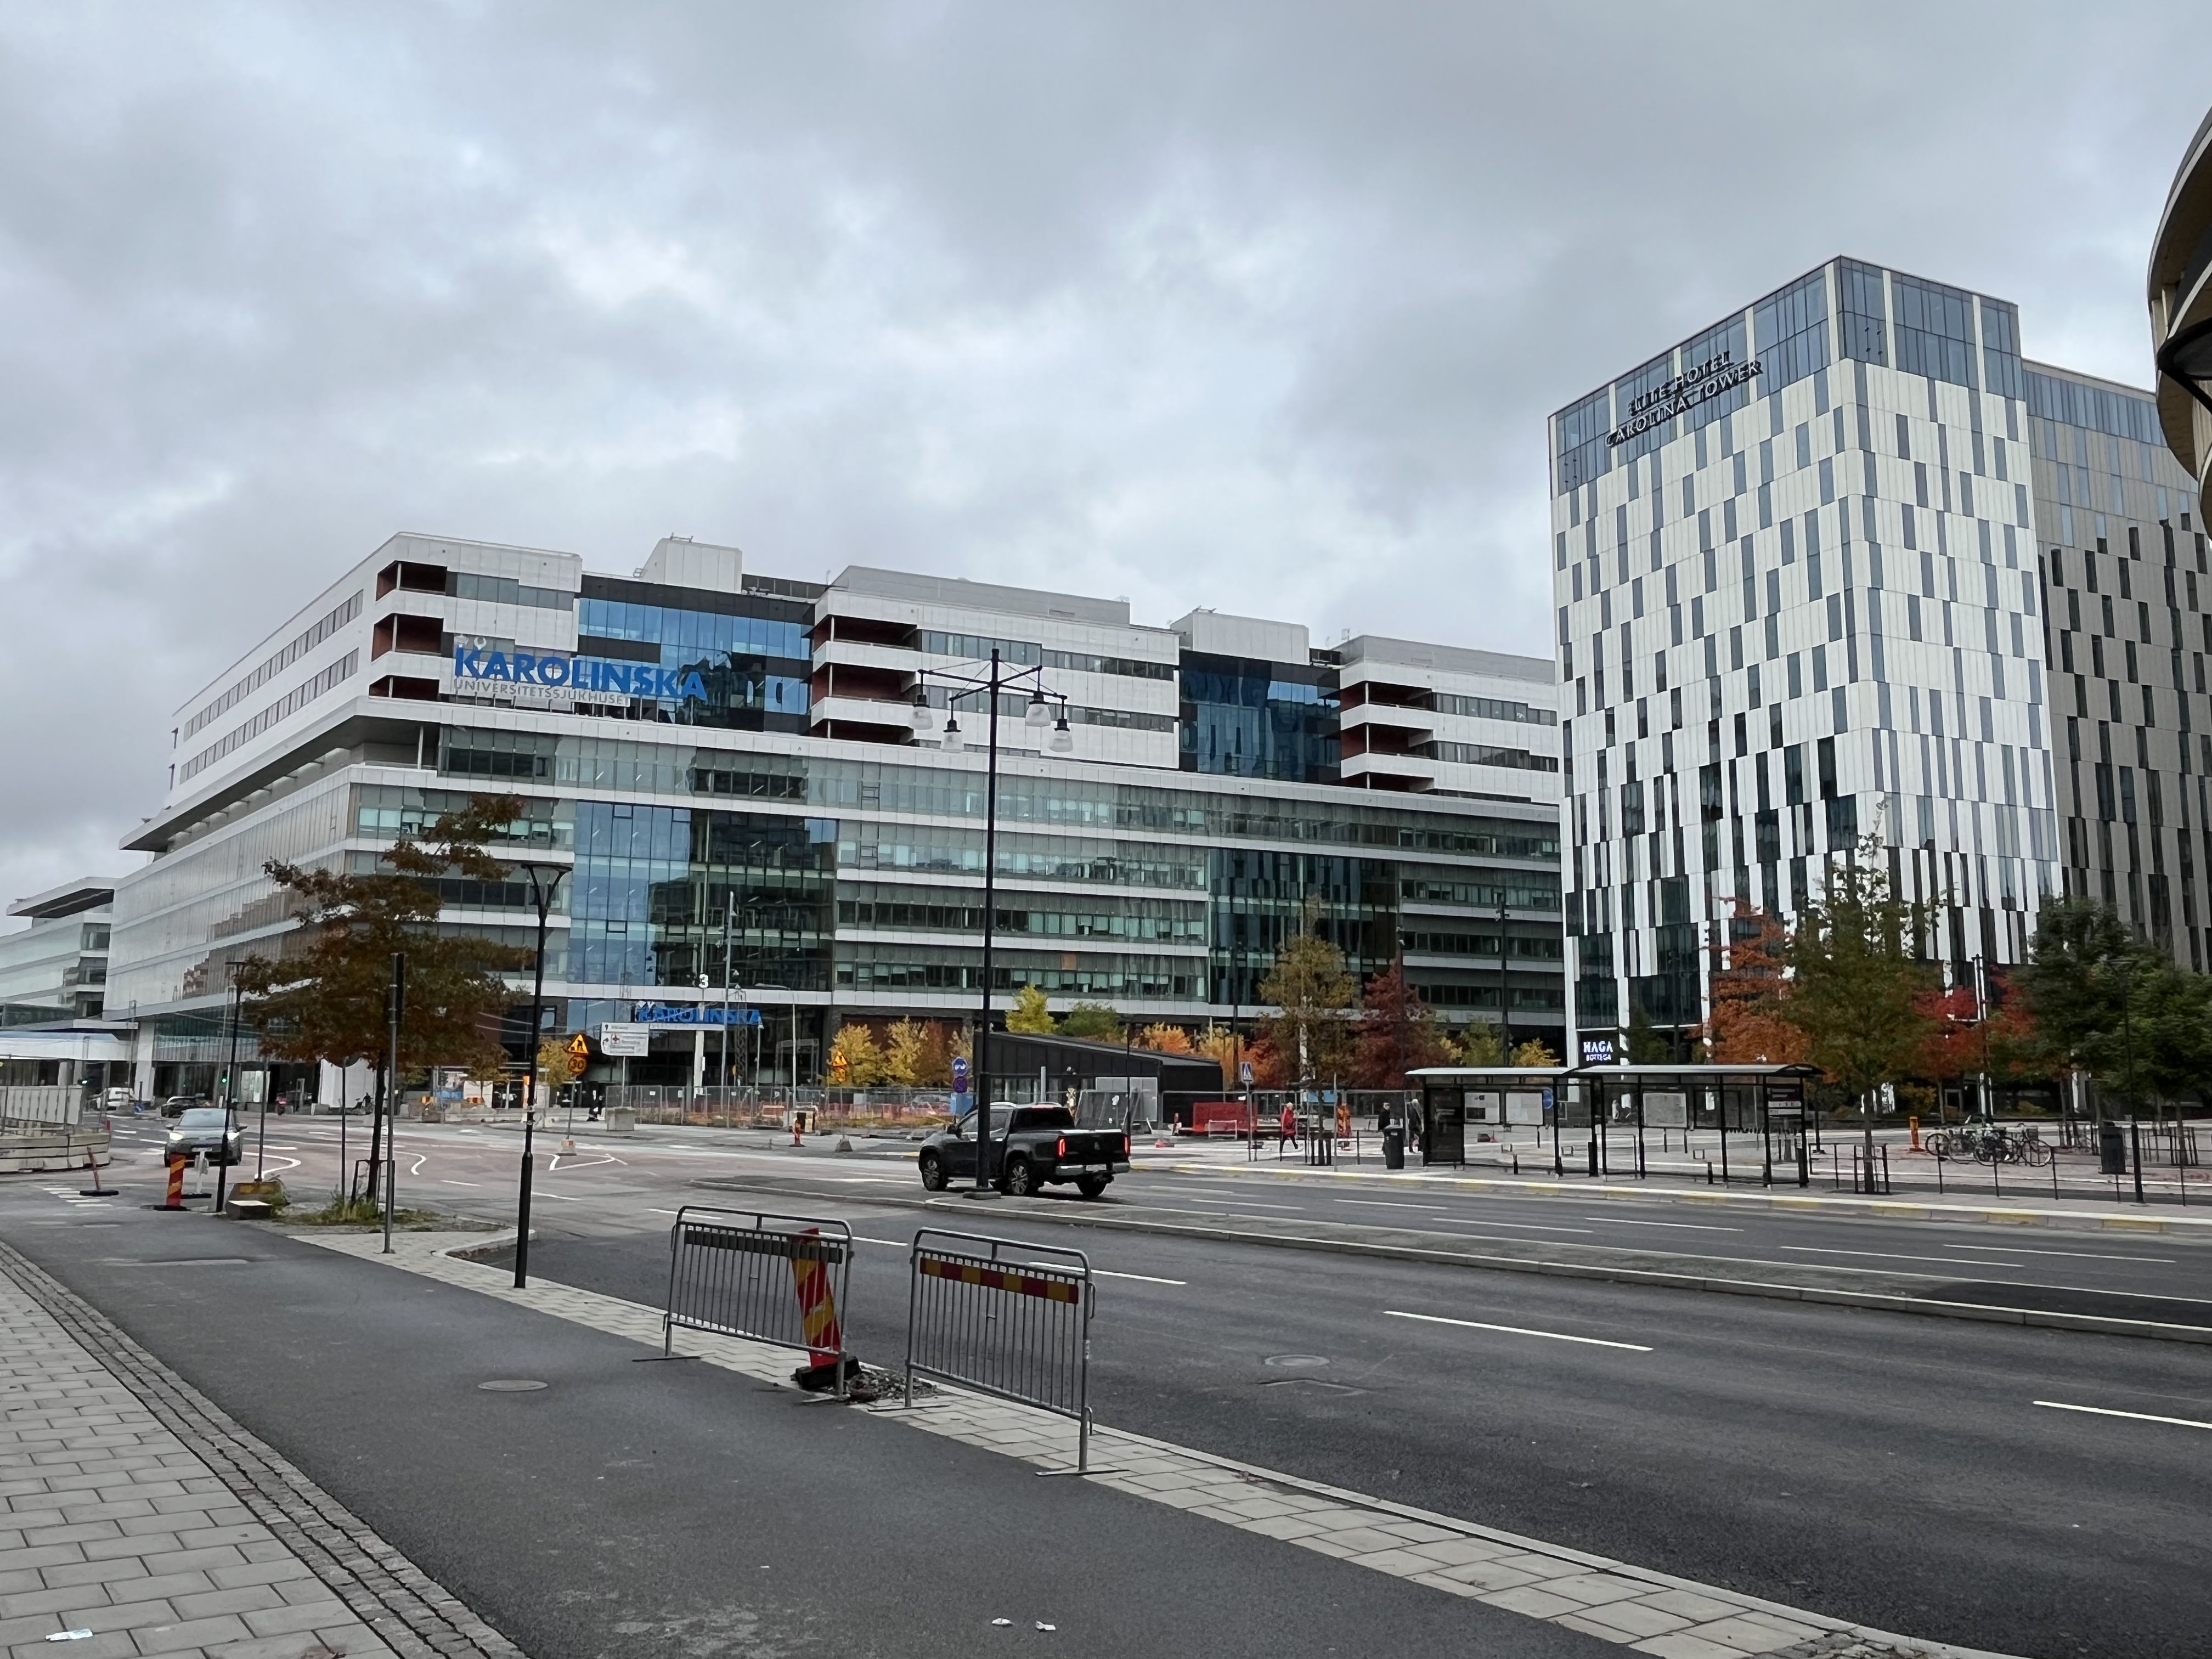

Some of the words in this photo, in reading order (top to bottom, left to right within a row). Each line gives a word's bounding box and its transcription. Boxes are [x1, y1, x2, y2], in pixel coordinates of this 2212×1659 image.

[1628, 382, 1672, 416] ELITE
[1674, 351, 1733, 389] HOTEL
[1606, 395, 1690, 447] CAROLINA
[1695, 360, 1763, 404] TOWER
[455, 647, 708, 702] KAROLINSKA
[455, 678, 630, 706] UNIVERSITETSSJUKHUSET
[698, 974, 709, 988] 3
[1583, 1040, 1613, 1053] HAGA
[571, 1059, 584, 1069] 30
